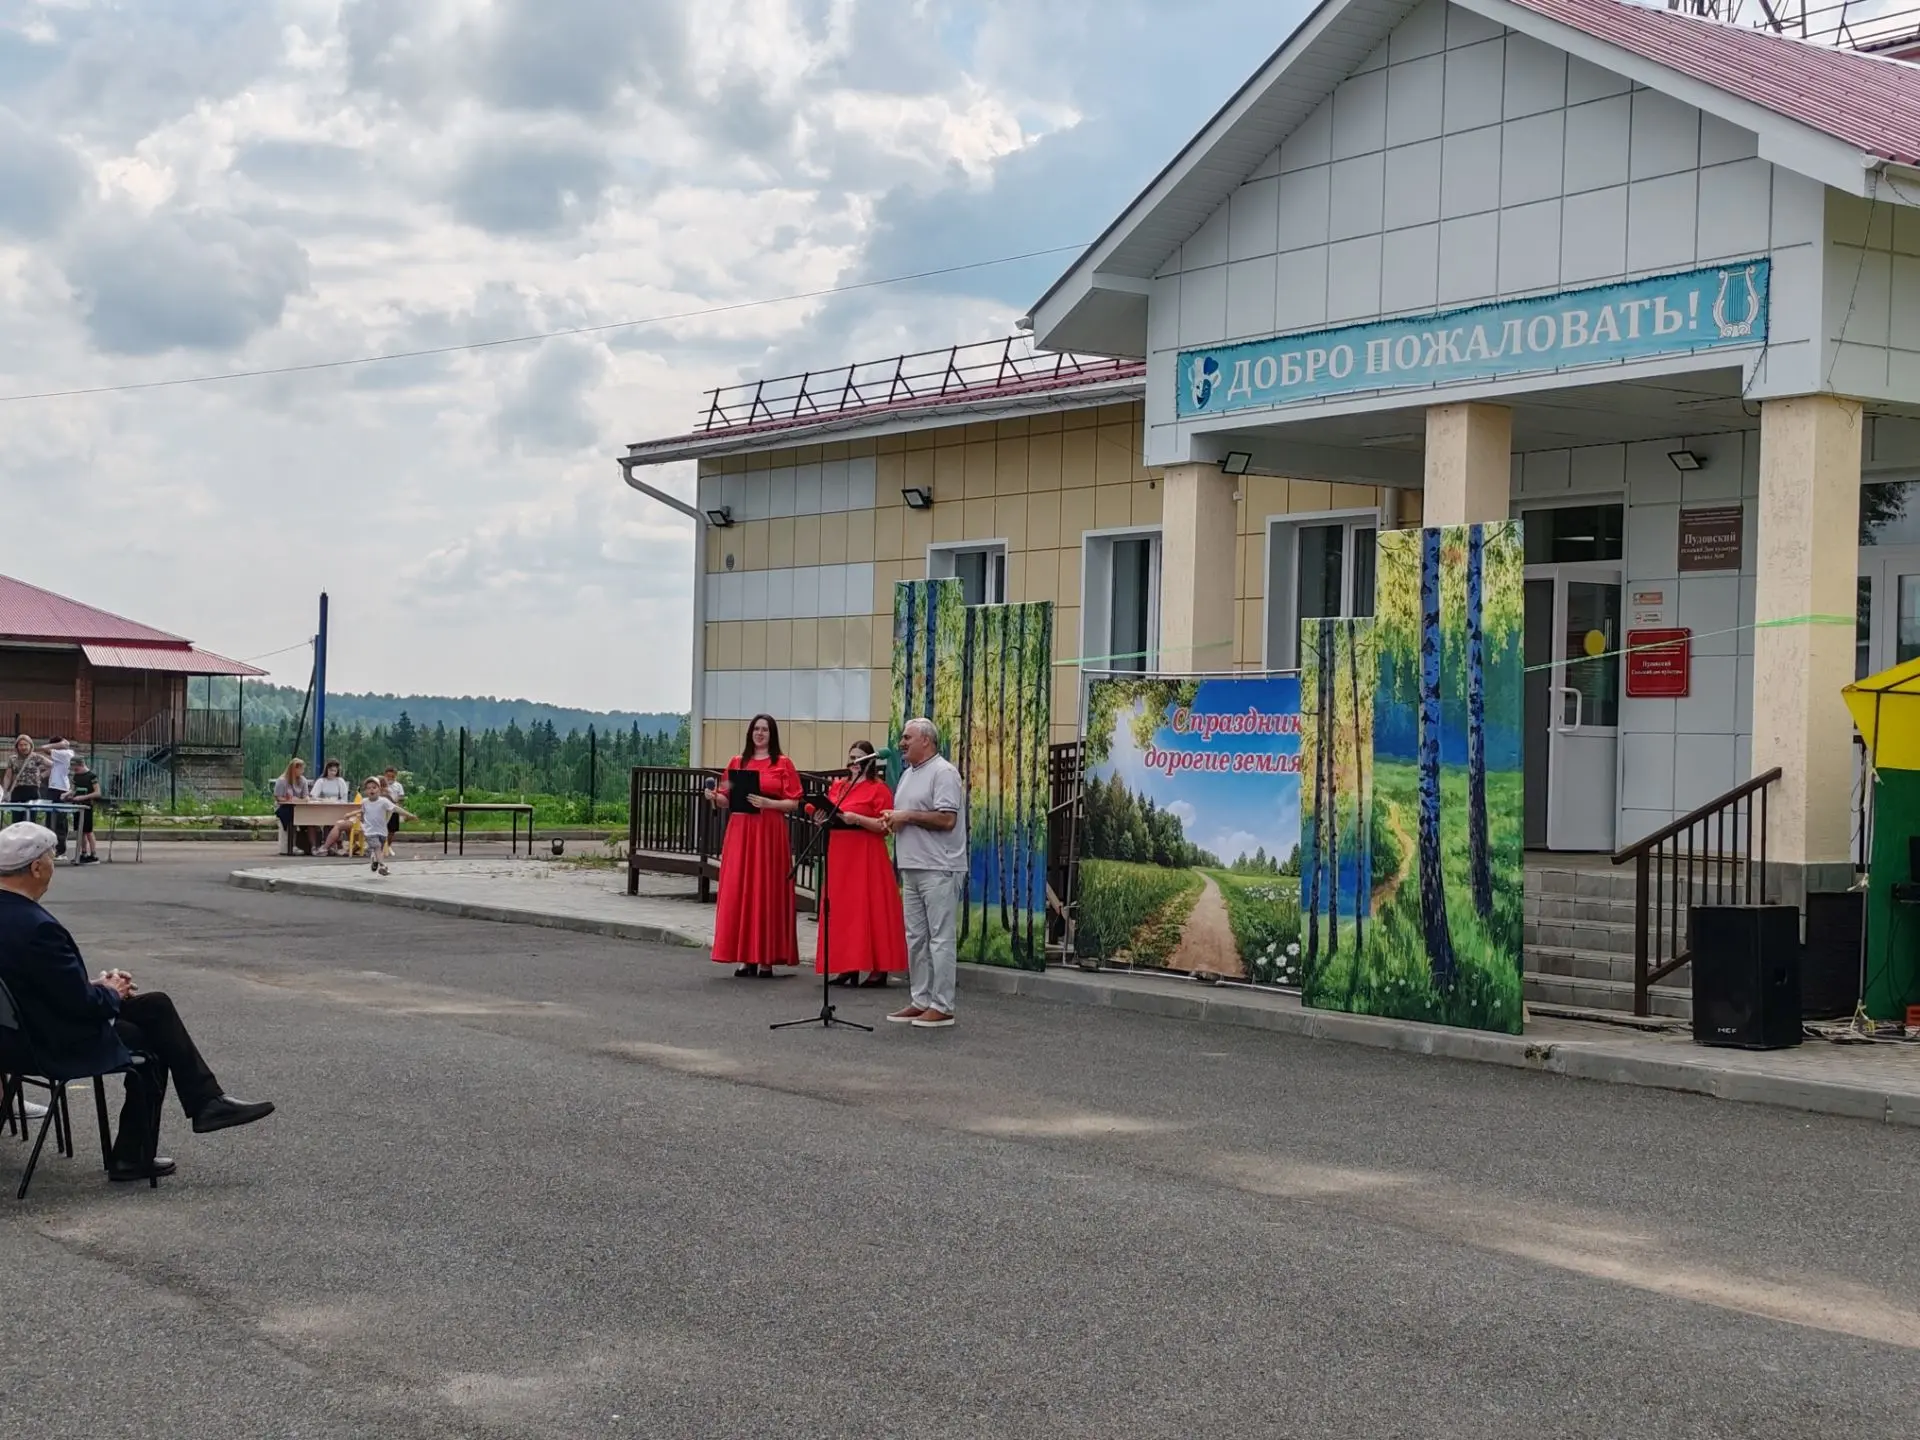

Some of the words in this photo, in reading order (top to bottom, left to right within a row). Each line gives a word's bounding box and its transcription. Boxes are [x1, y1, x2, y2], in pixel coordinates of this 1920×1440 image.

[1228, 345, 1354, 401] ДОБРО
[1366, 290, 1699, 375] ПОЖАЛОВАТЬ!
[1172, 706, 1188, 734] С
[1144, 744, 1230, 777] дорогие
